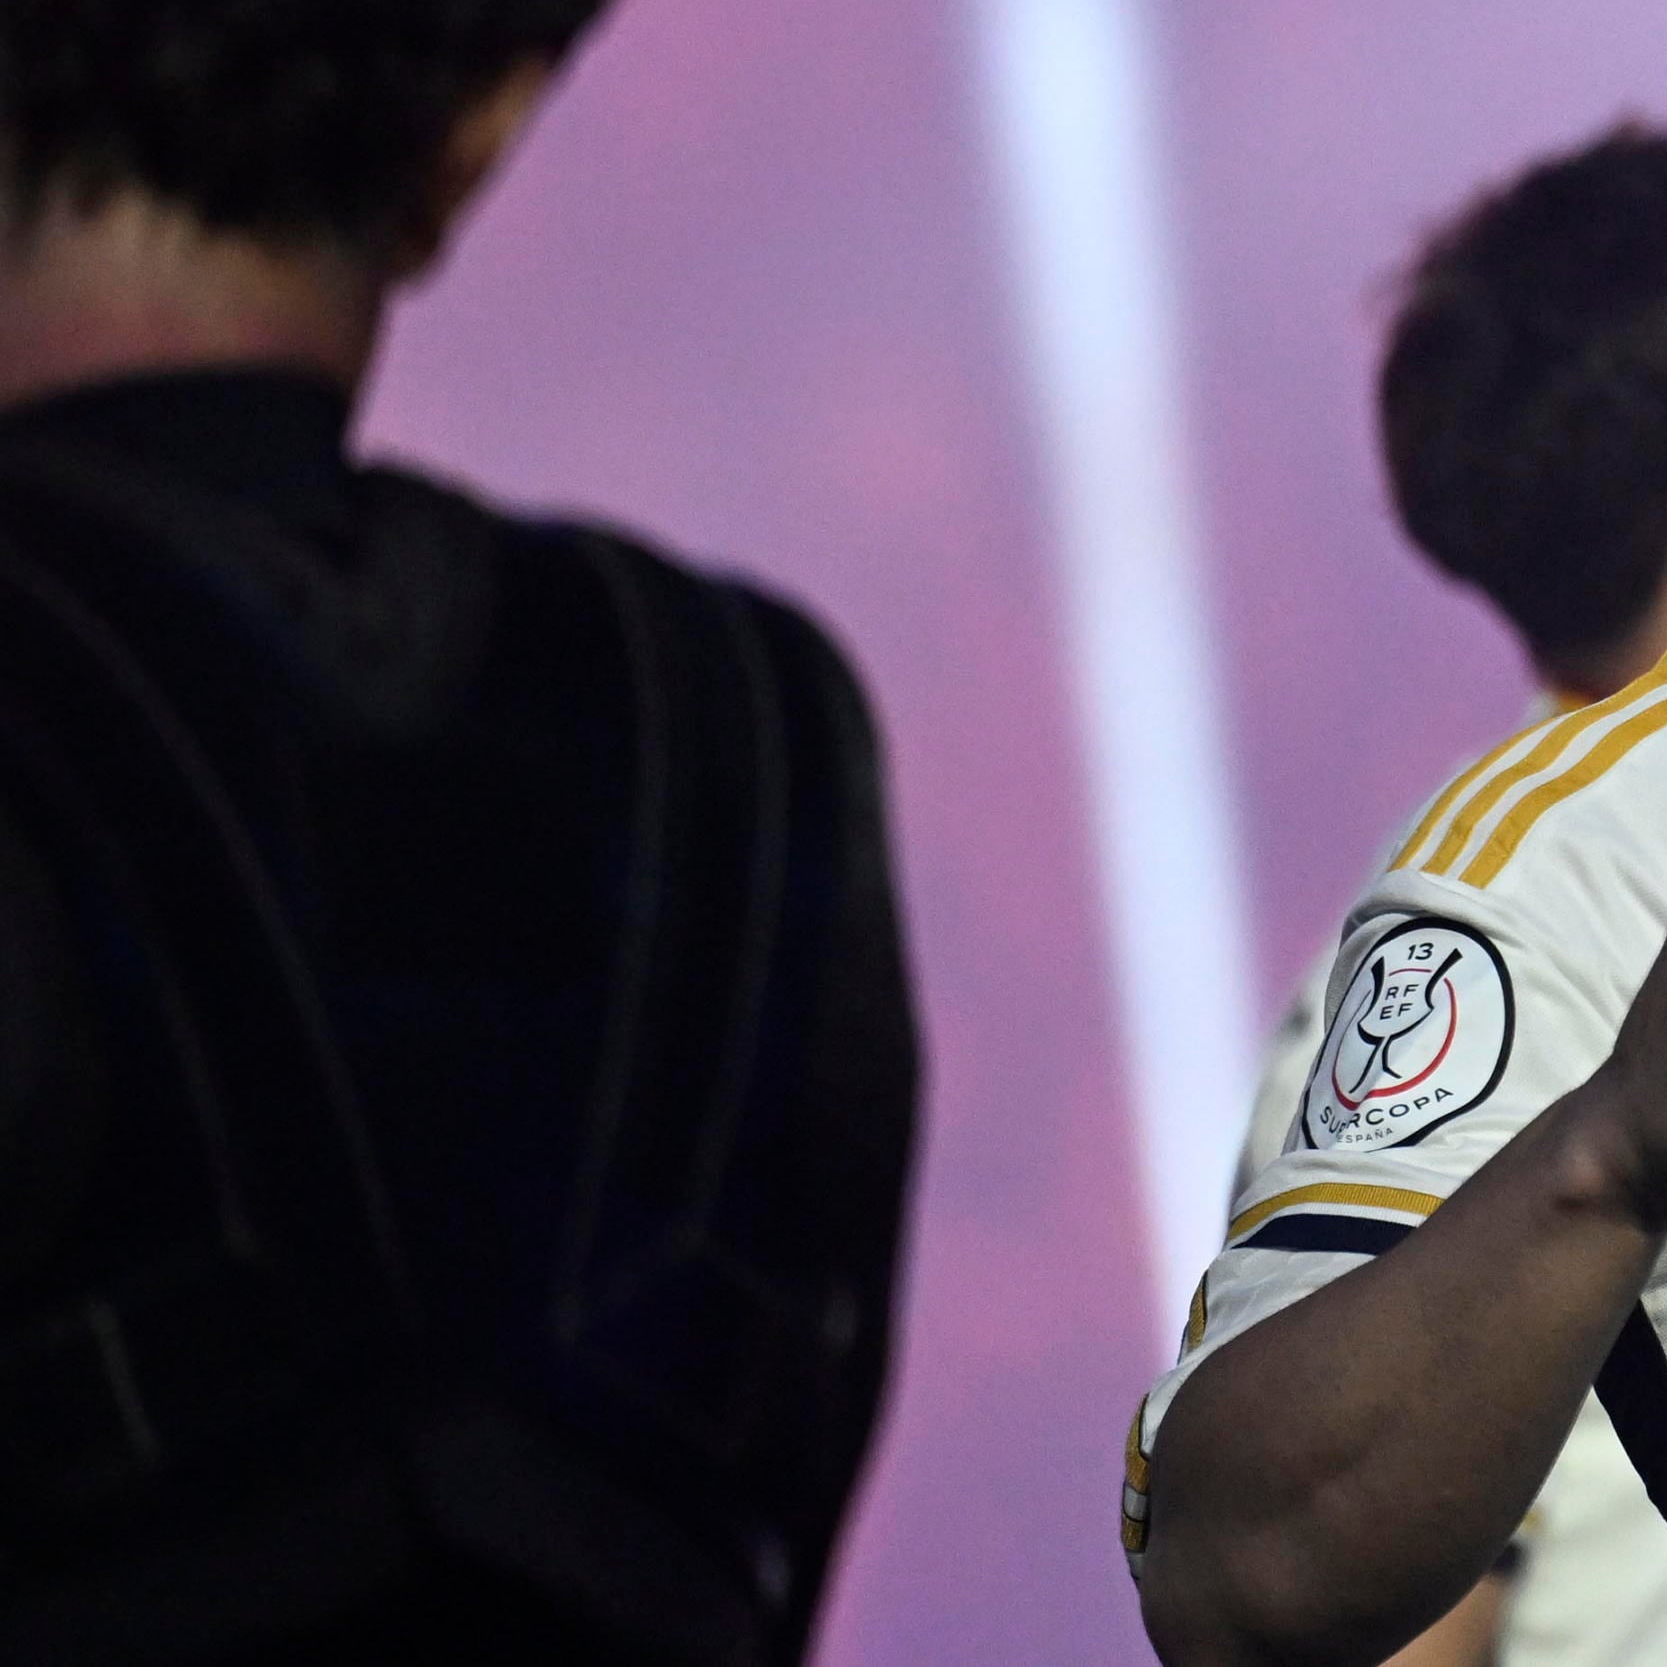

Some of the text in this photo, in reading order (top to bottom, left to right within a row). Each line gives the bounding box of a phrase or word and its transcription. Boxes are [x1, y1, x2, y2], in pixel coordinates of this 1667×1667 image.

[1407, 942, 1434, 960] 13
[1385, 984, 1420, 1000] RF
[1379, 1003, 1413, 1020] EF
[1320, 1088, 1454, 1134] SUPRCOPA
